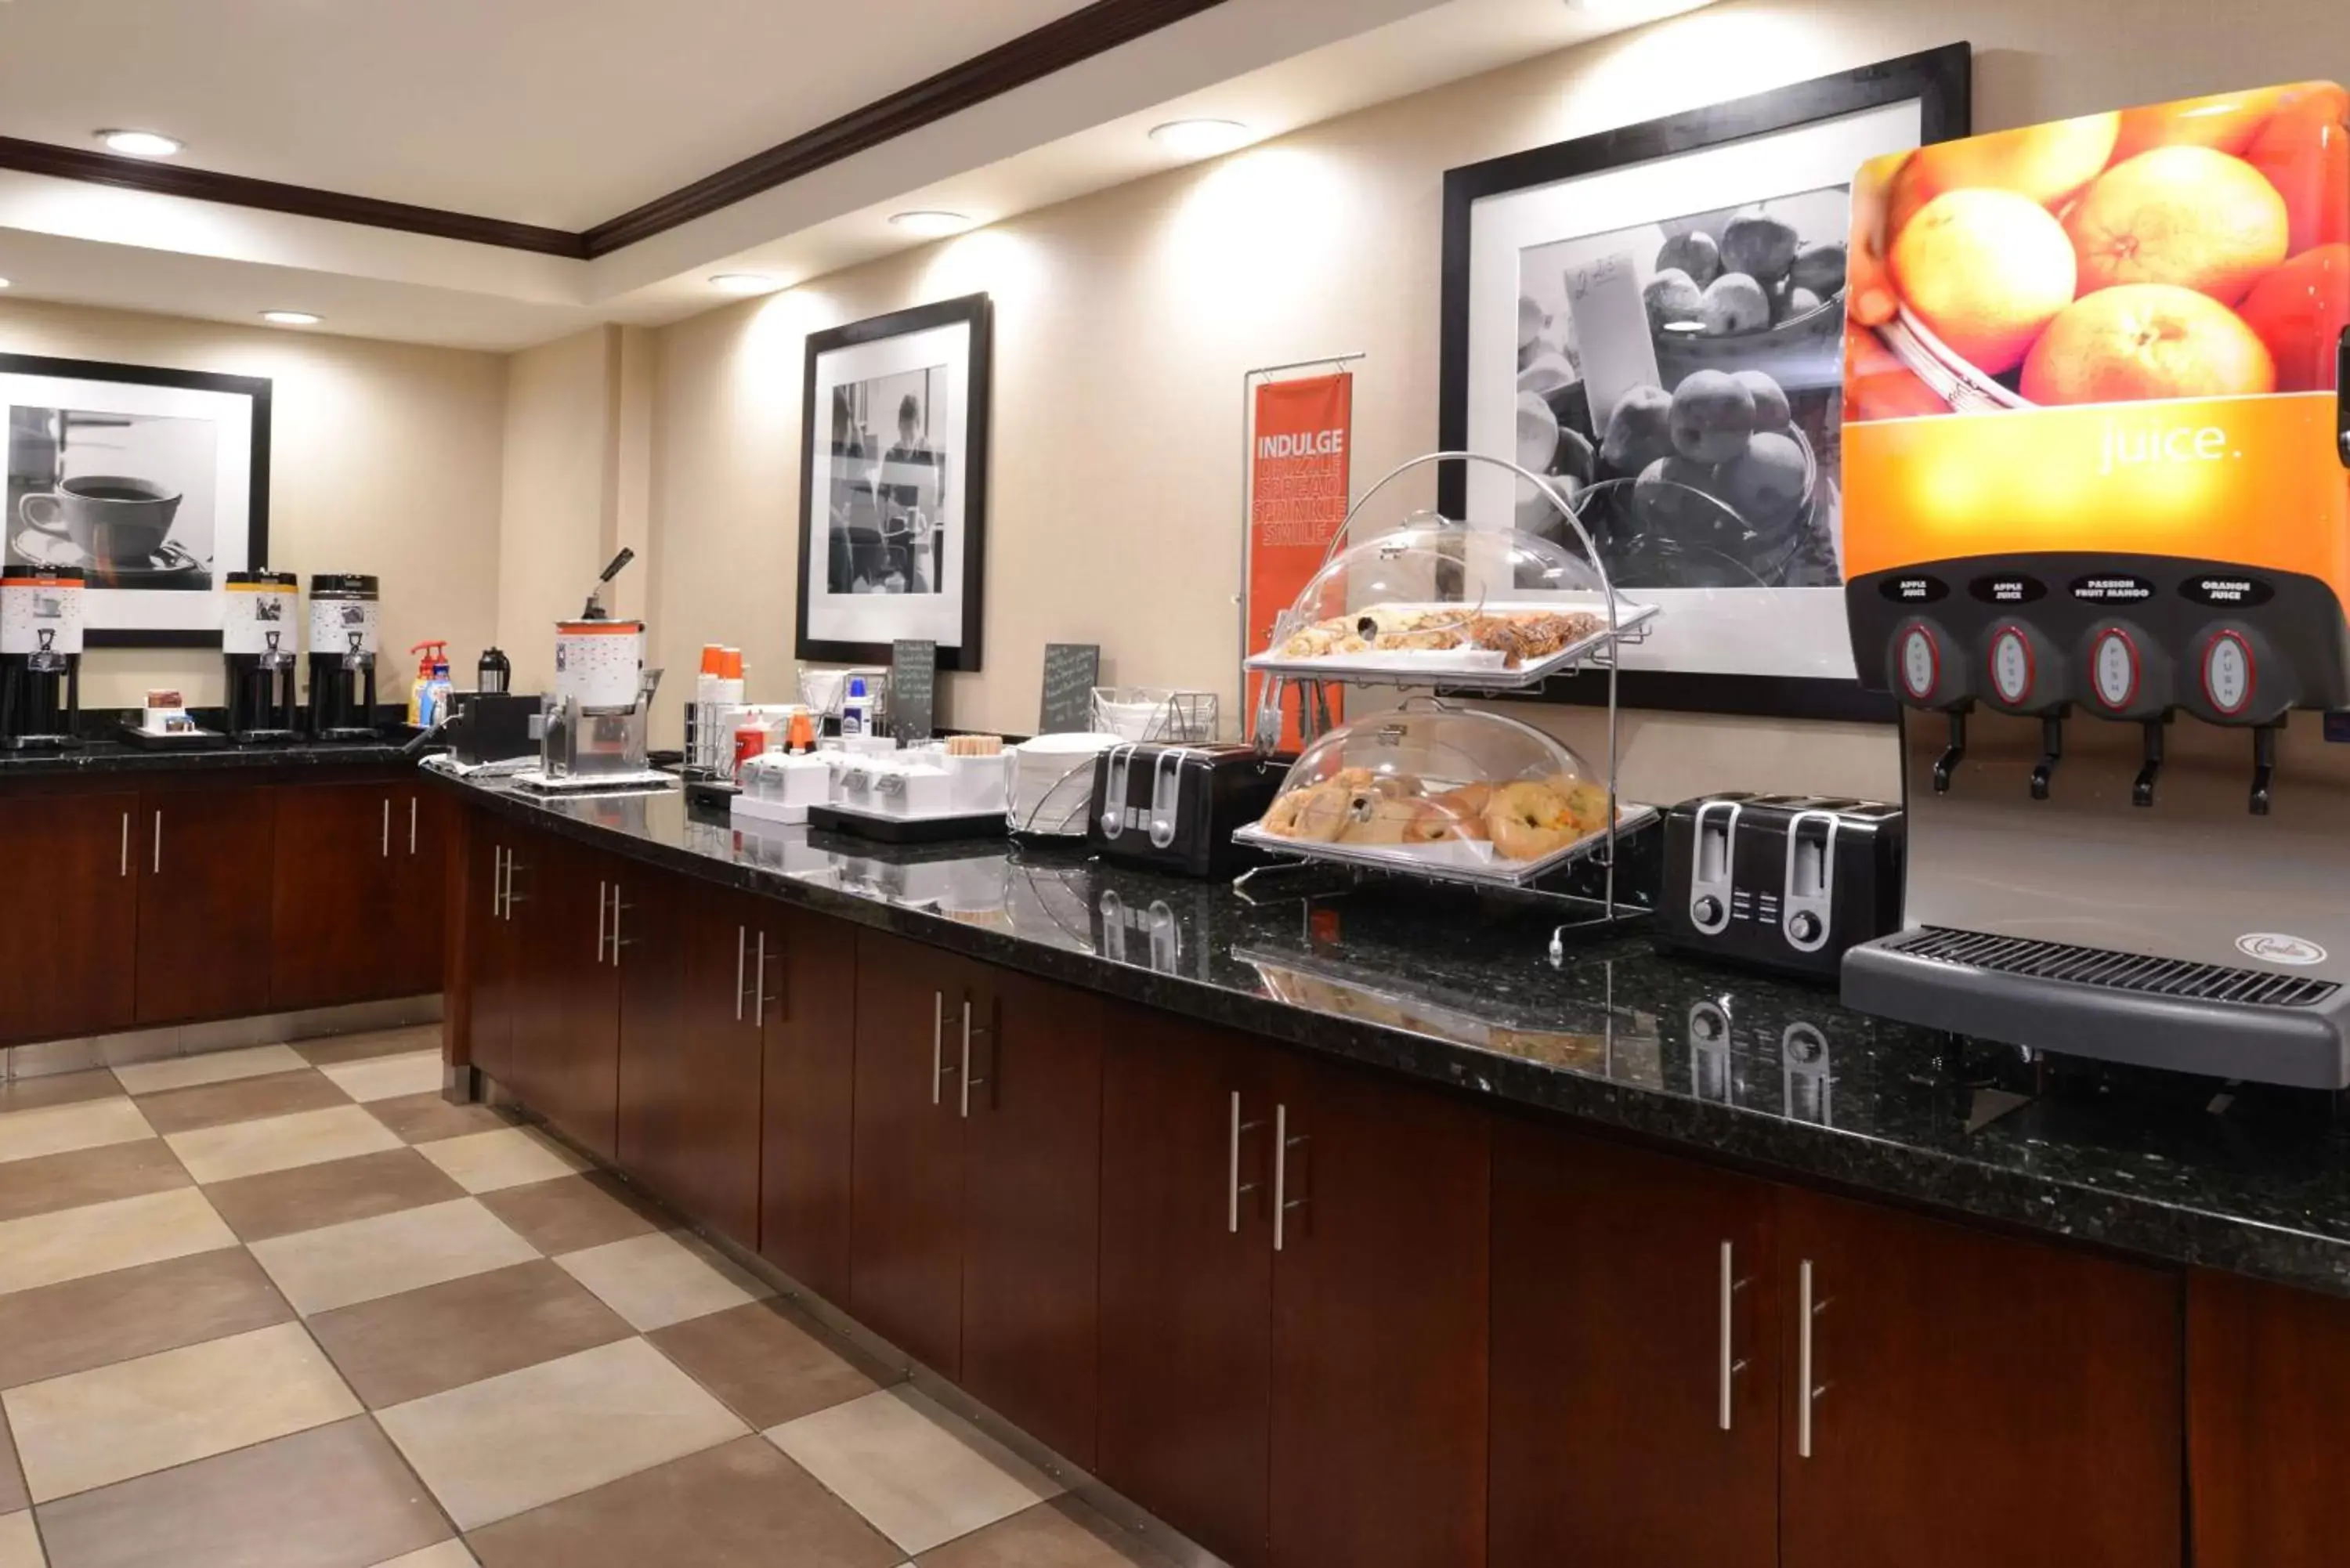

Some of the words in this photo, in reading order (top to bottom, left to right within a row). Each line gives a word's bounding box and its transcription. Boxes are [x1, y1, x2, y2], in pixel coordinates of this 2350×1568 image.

[1258, 429, 1343, 459] INDULGE
[2099, 417, 2242, 475] juice.
[1259, 452, 1342, 479] DRIZZLE
[1259, 475, 1342, 500] SPREAD
[1253, 497, 1347, 525] SPRINKLE
[1900, 580, 1927, 589] APPLE
[1903, 588, 1926, 597] JUICE
[1994, 583, 2023, 591] APPLE
[2202, 581, 2251, 591] ORANGE
[2107, 589, 2149, 598] MANGO
[2210, 591, 2241, 600] JUICE
[2223, 650, 2232, 698] PUSH
